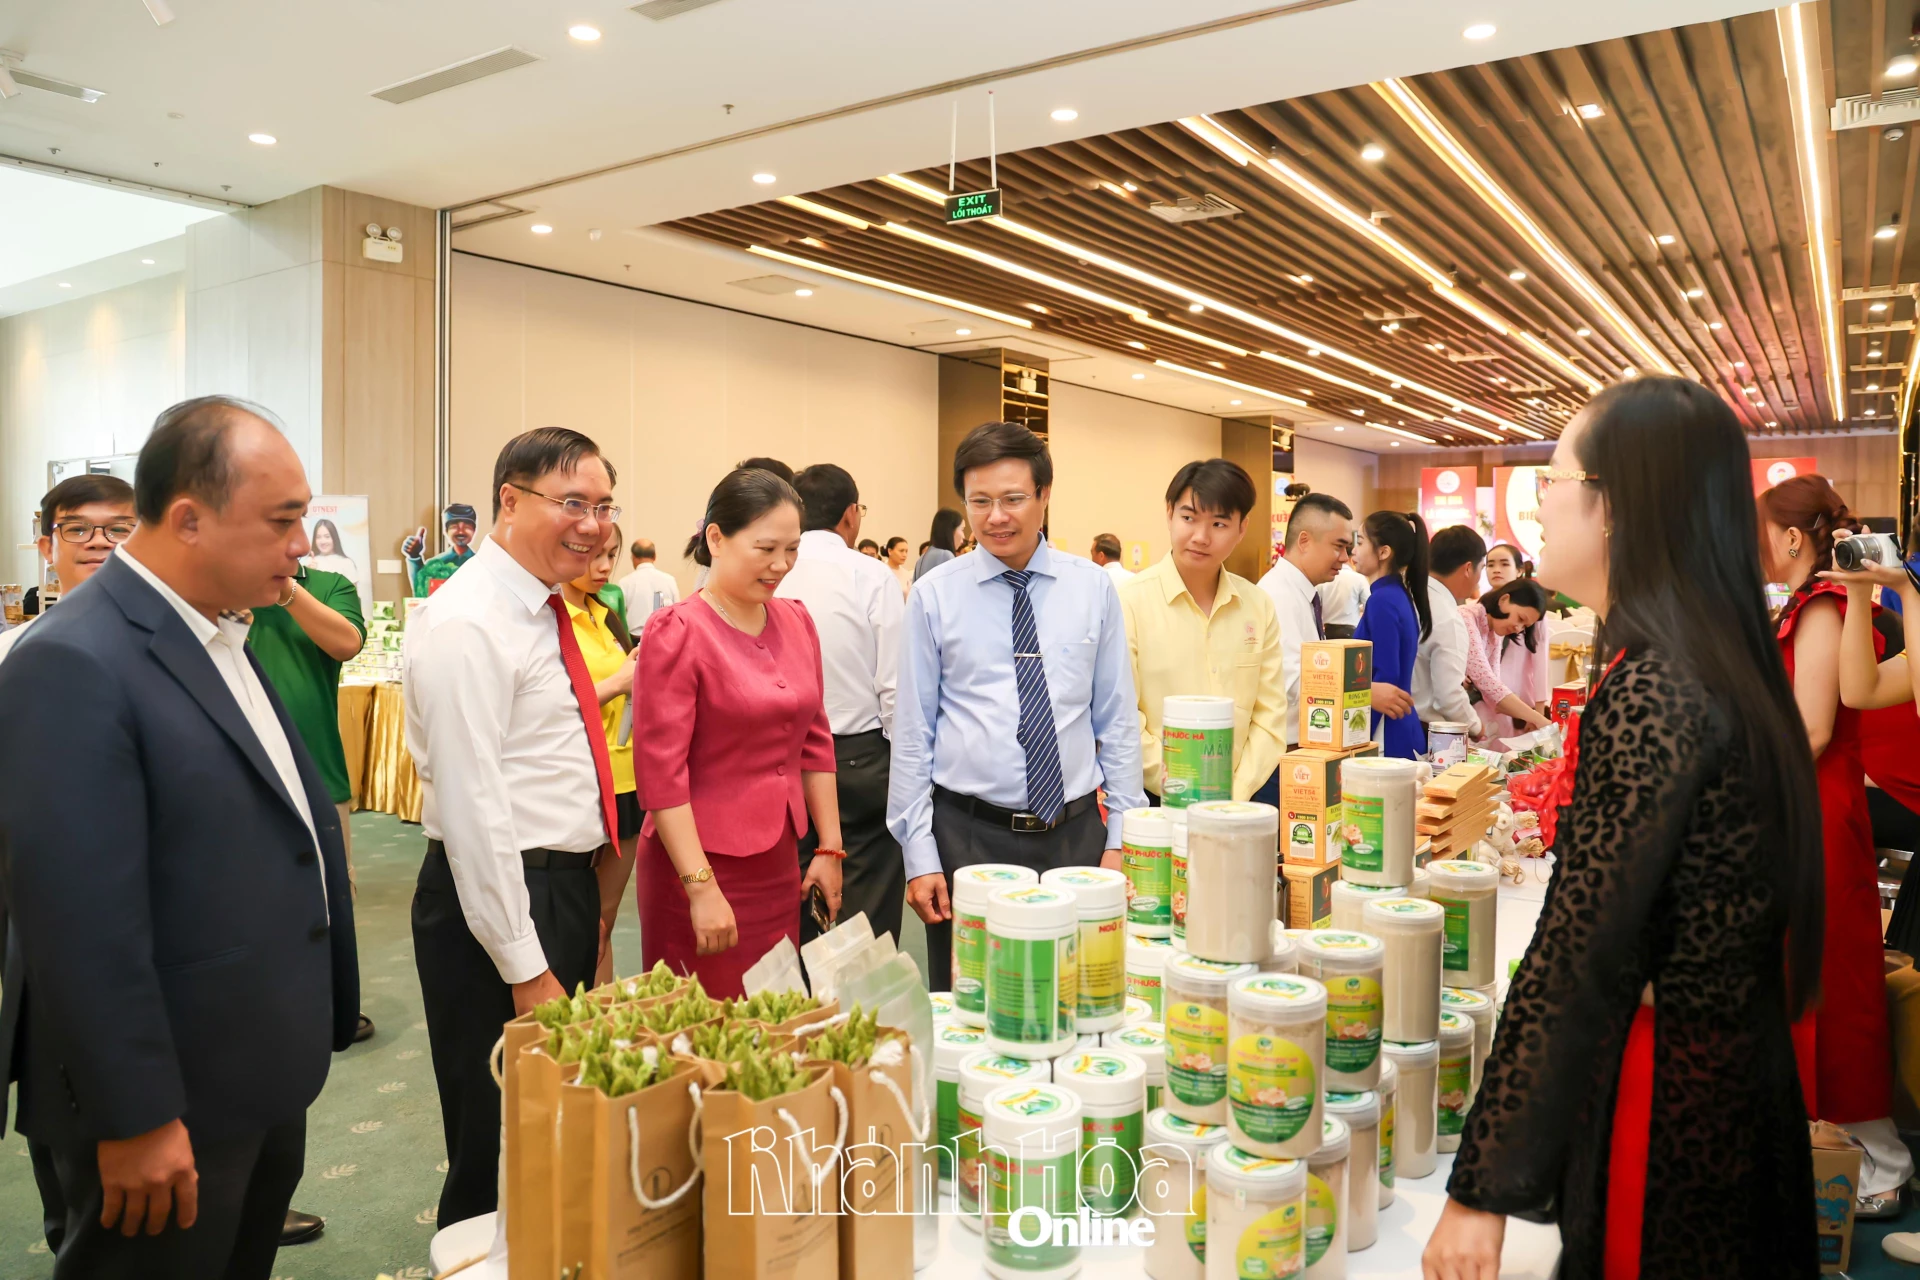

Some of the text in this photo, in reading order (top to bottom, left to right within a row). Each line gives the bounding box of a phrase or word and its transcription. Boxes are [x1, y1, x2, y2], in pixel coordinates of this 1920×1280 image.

[958, 194, 987, 207] EXIT
[952, 204, 993, 219] LỐI THOÁT
